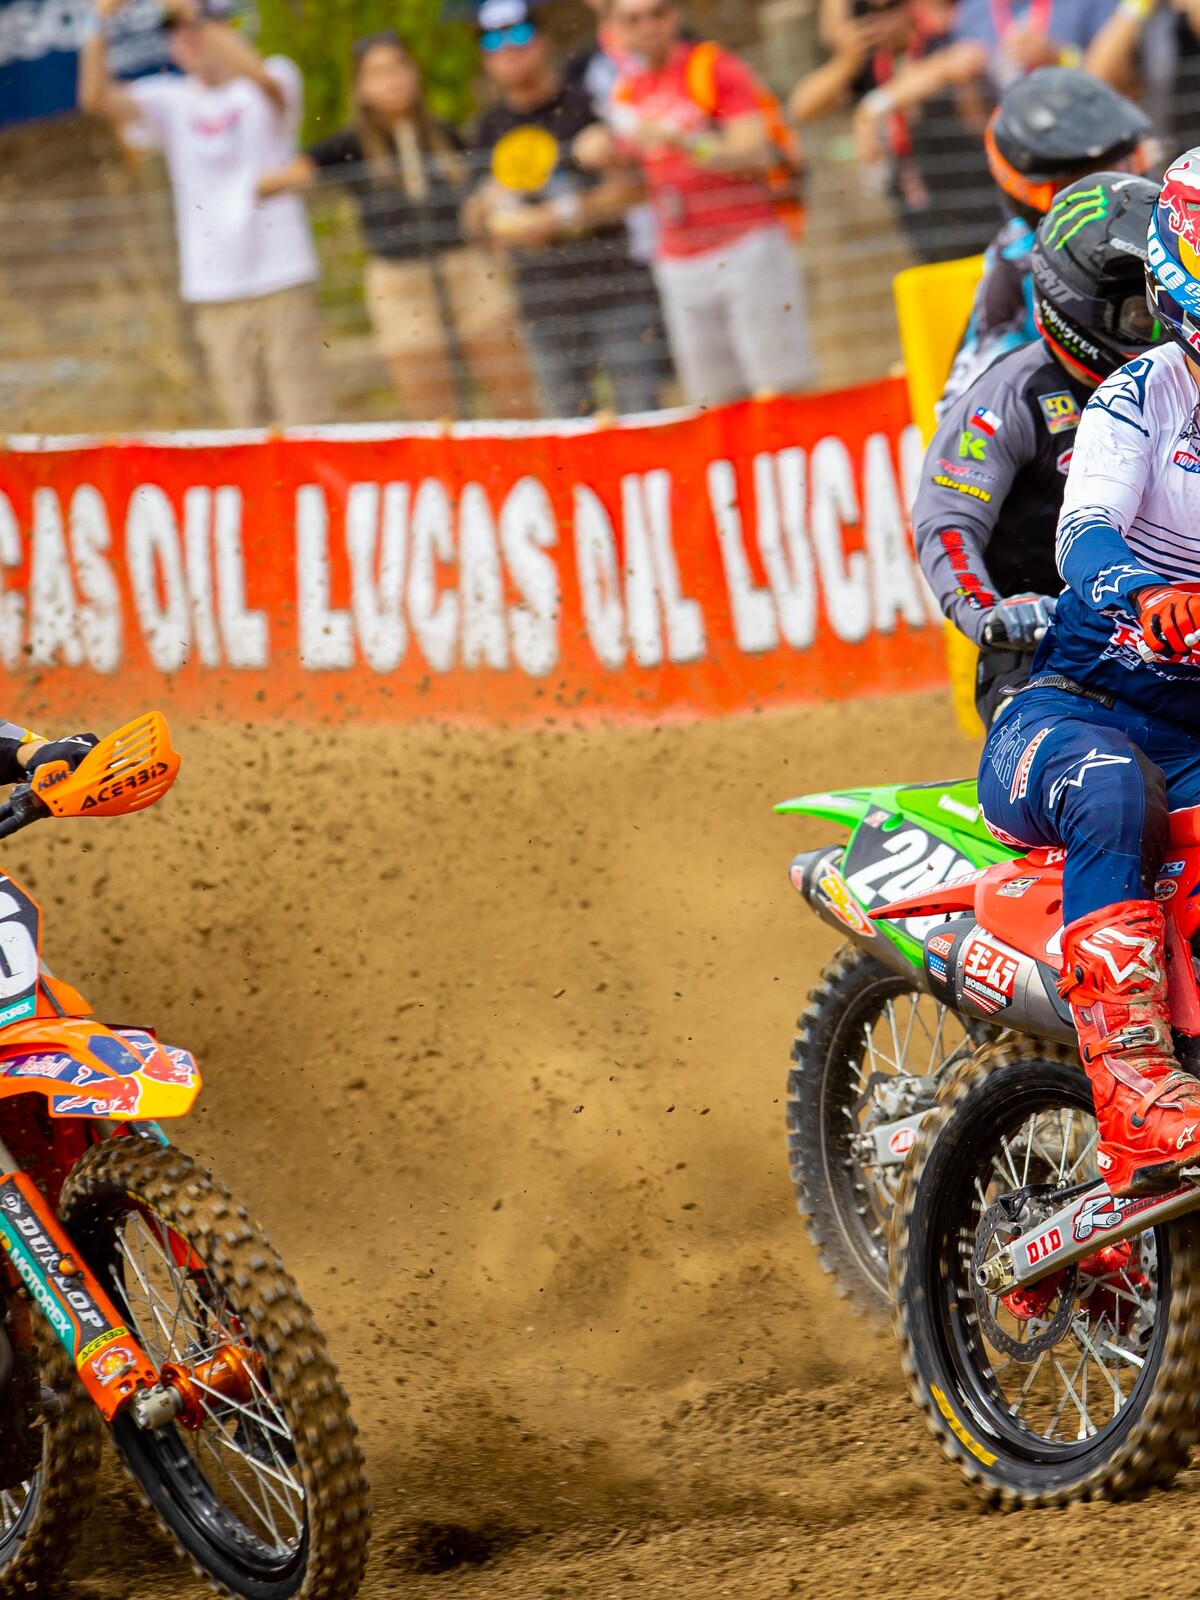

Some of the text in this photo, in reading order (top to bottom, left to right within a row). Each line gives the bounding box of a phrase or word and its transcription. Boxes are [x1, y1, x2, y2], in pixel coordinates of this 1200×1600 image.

[1175, 453, 1200, 473] 100%
[126, 482, 269, 673] OIL
[296, 474, 561, 679] LUCAS
[573, 469, 707, 671] OIL
[36, 768, 68, 793] KTM
[79, 761, 169, 812] ACERBIS
[964, 975, 1008, 1007] YOSHIMURA
[10, 1247, 73, 1338] MOTOREX
[14, 1215, 105, 1329] DUNLOP
[80, 1328, 126, 1361] ACERBIS
